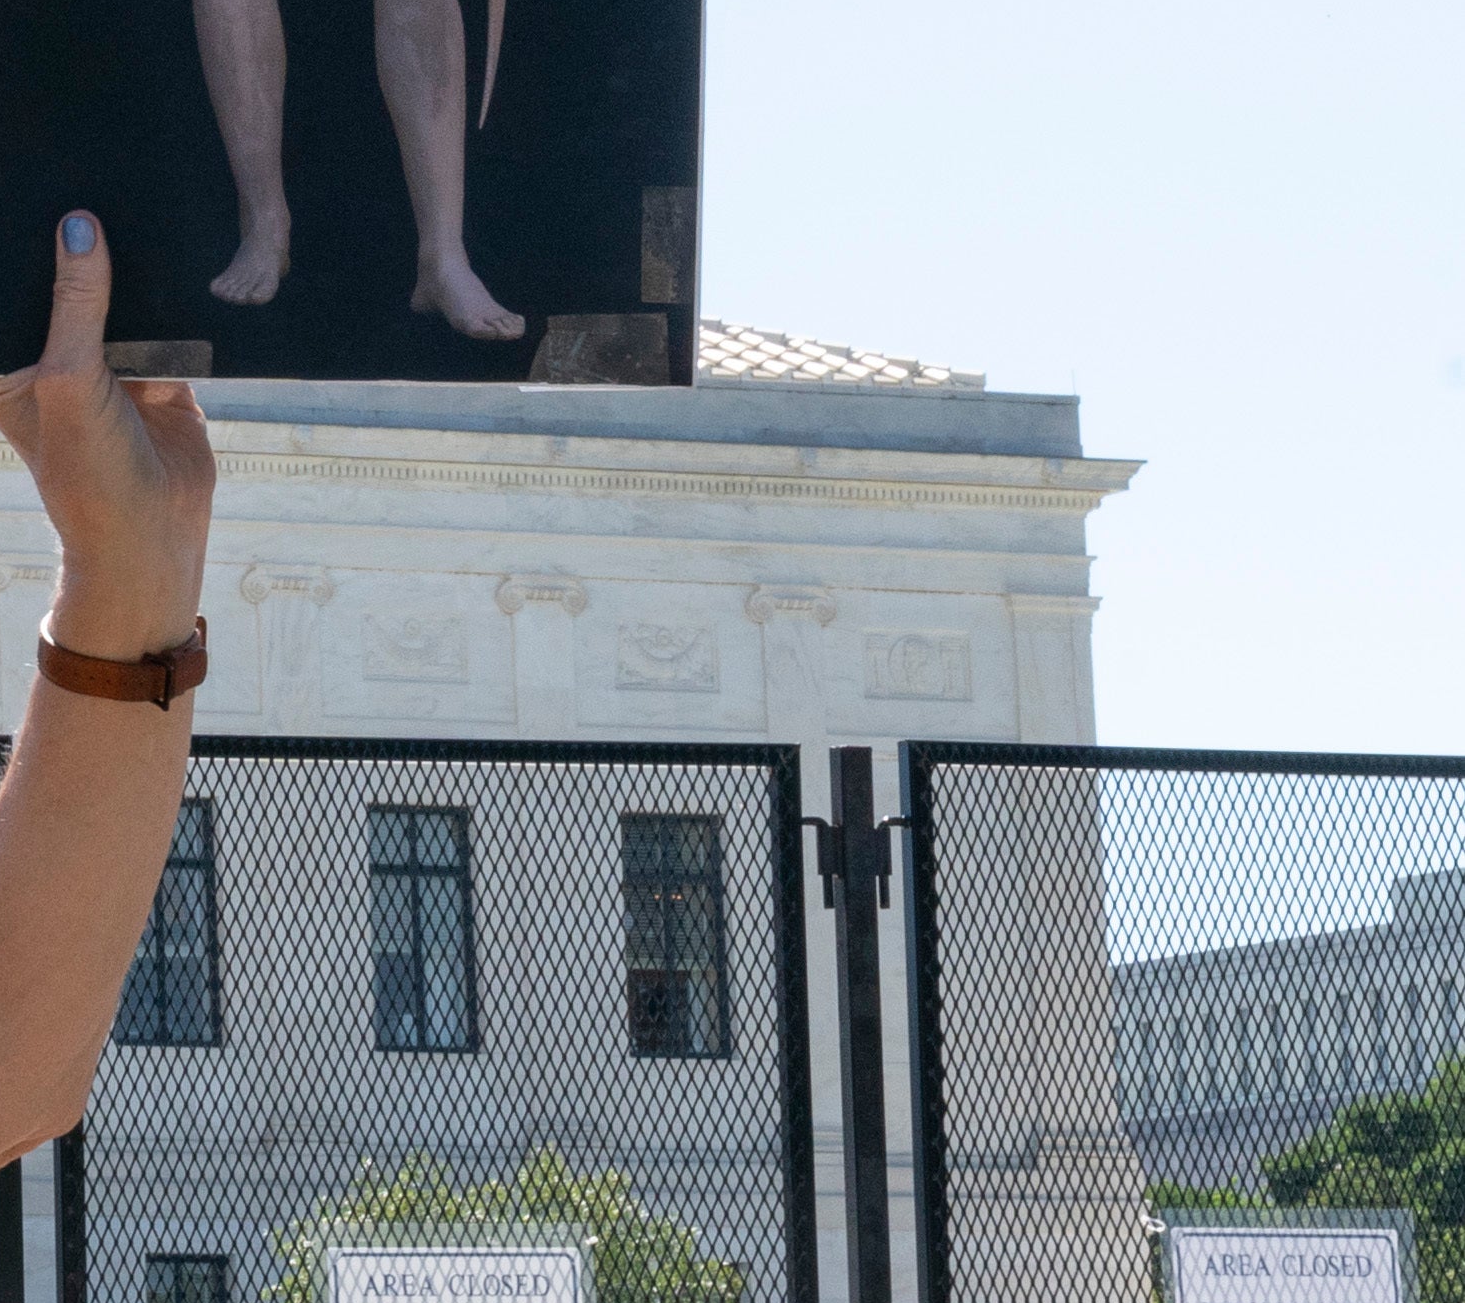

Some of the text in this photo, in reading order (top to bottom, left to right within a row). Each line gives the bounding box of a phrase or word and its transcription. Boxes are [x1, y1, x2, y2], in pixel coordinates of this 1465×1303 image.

[1204, 1253, 1373, 1278] AREA CLOSED
[363, 1273, 551, 1297] AREA CLOSED
